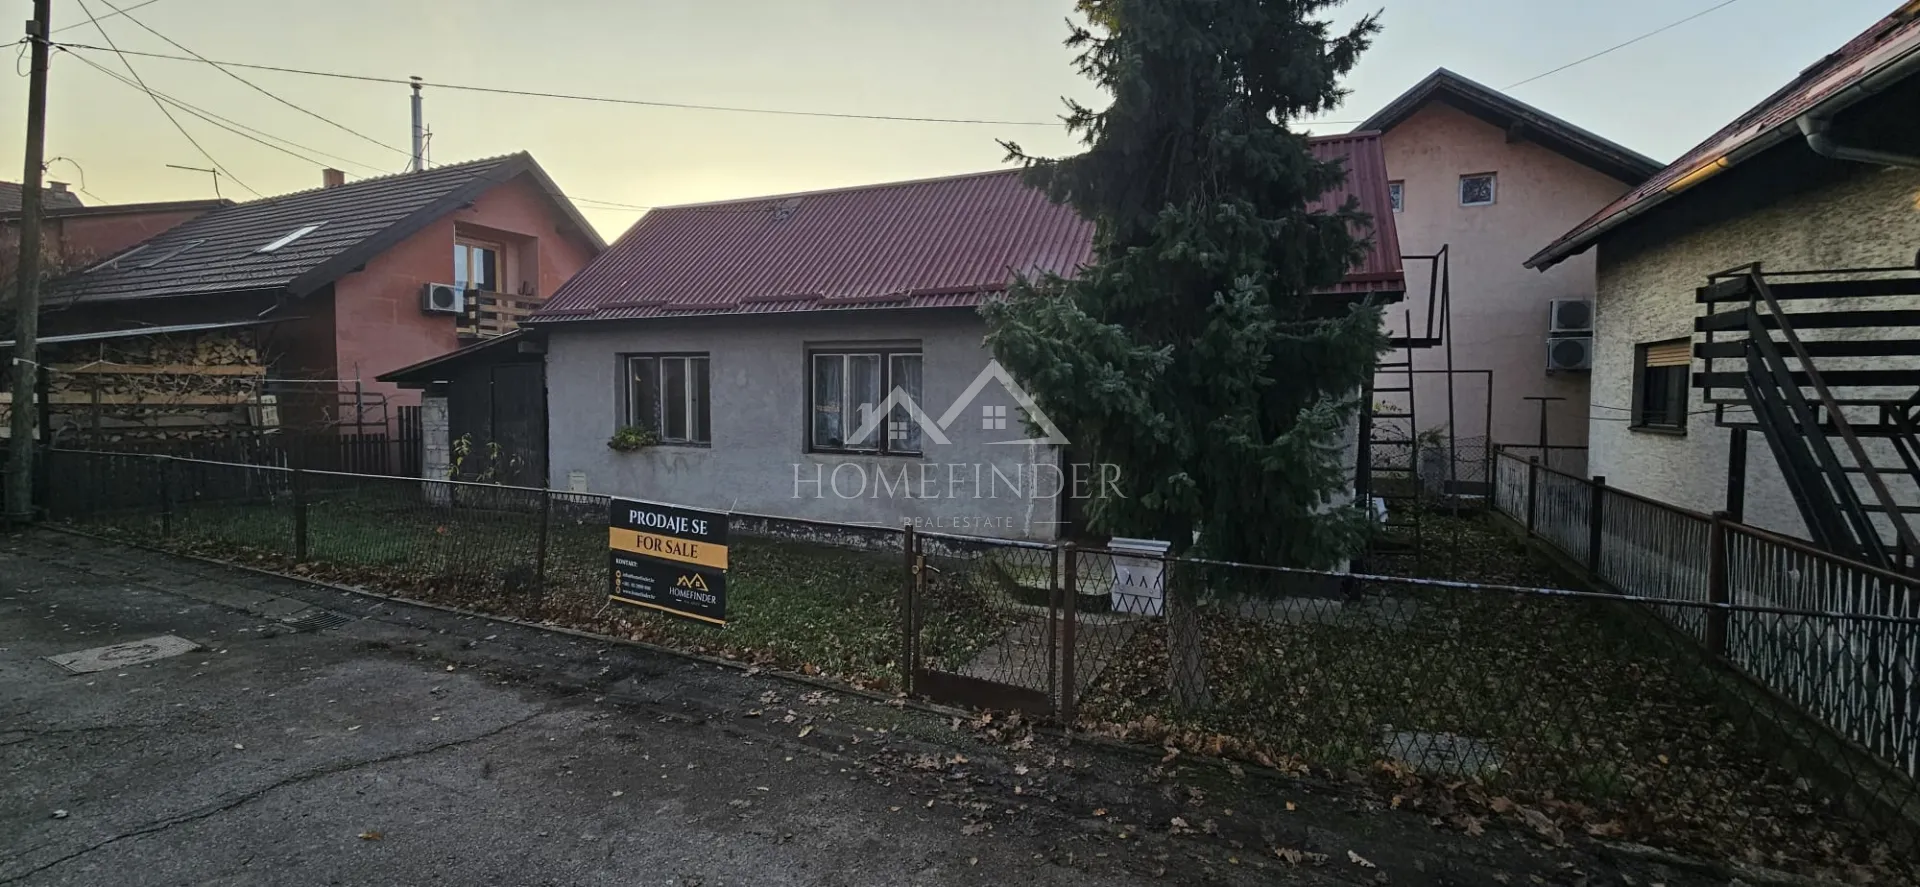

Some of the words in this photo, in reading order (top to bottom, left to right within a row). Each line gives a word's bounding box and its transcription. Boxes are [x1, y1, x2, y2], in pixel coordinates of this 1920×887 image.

[629, 509, 689, 534] PRODAJE
[691, 519, 708, 535] SE
[636, 534, 662, 553] FOR
[664, 539, 698, 559] SALE
[669, 586, 717, 604] HOMEFINDER
